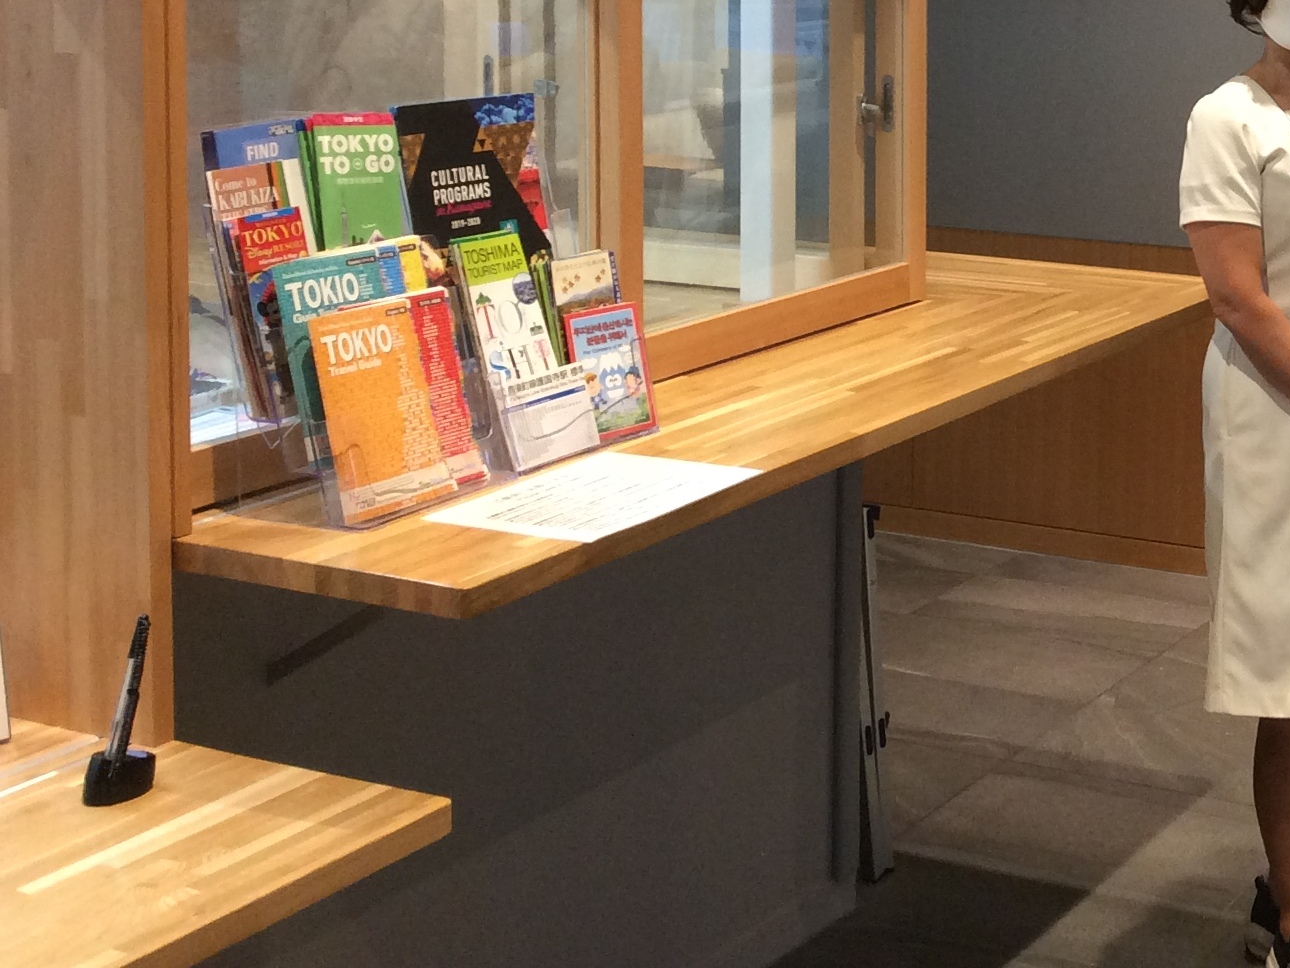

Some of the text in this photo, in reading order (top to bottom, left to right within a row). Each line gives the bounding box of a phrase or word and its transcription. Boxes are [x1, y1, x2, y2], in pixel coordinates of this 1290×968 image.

[246, 142, 279, 161] FIND
[317, 133, 394, 153] TOKYO
[320, 154, 395, 174] TO GO
[430, 163, 490, 187] CULTURAL
[433, 182, 492, 206] PROGRAMS
[241, 220, 303, 247] TOKYO
[464, 242, 520, 264] TOSHIMA
[468, 258, 523, 279] TOURIST MAP
[284, 273, 359, 311] TOKIO
[320, 323, 393, 365] TOKYO
